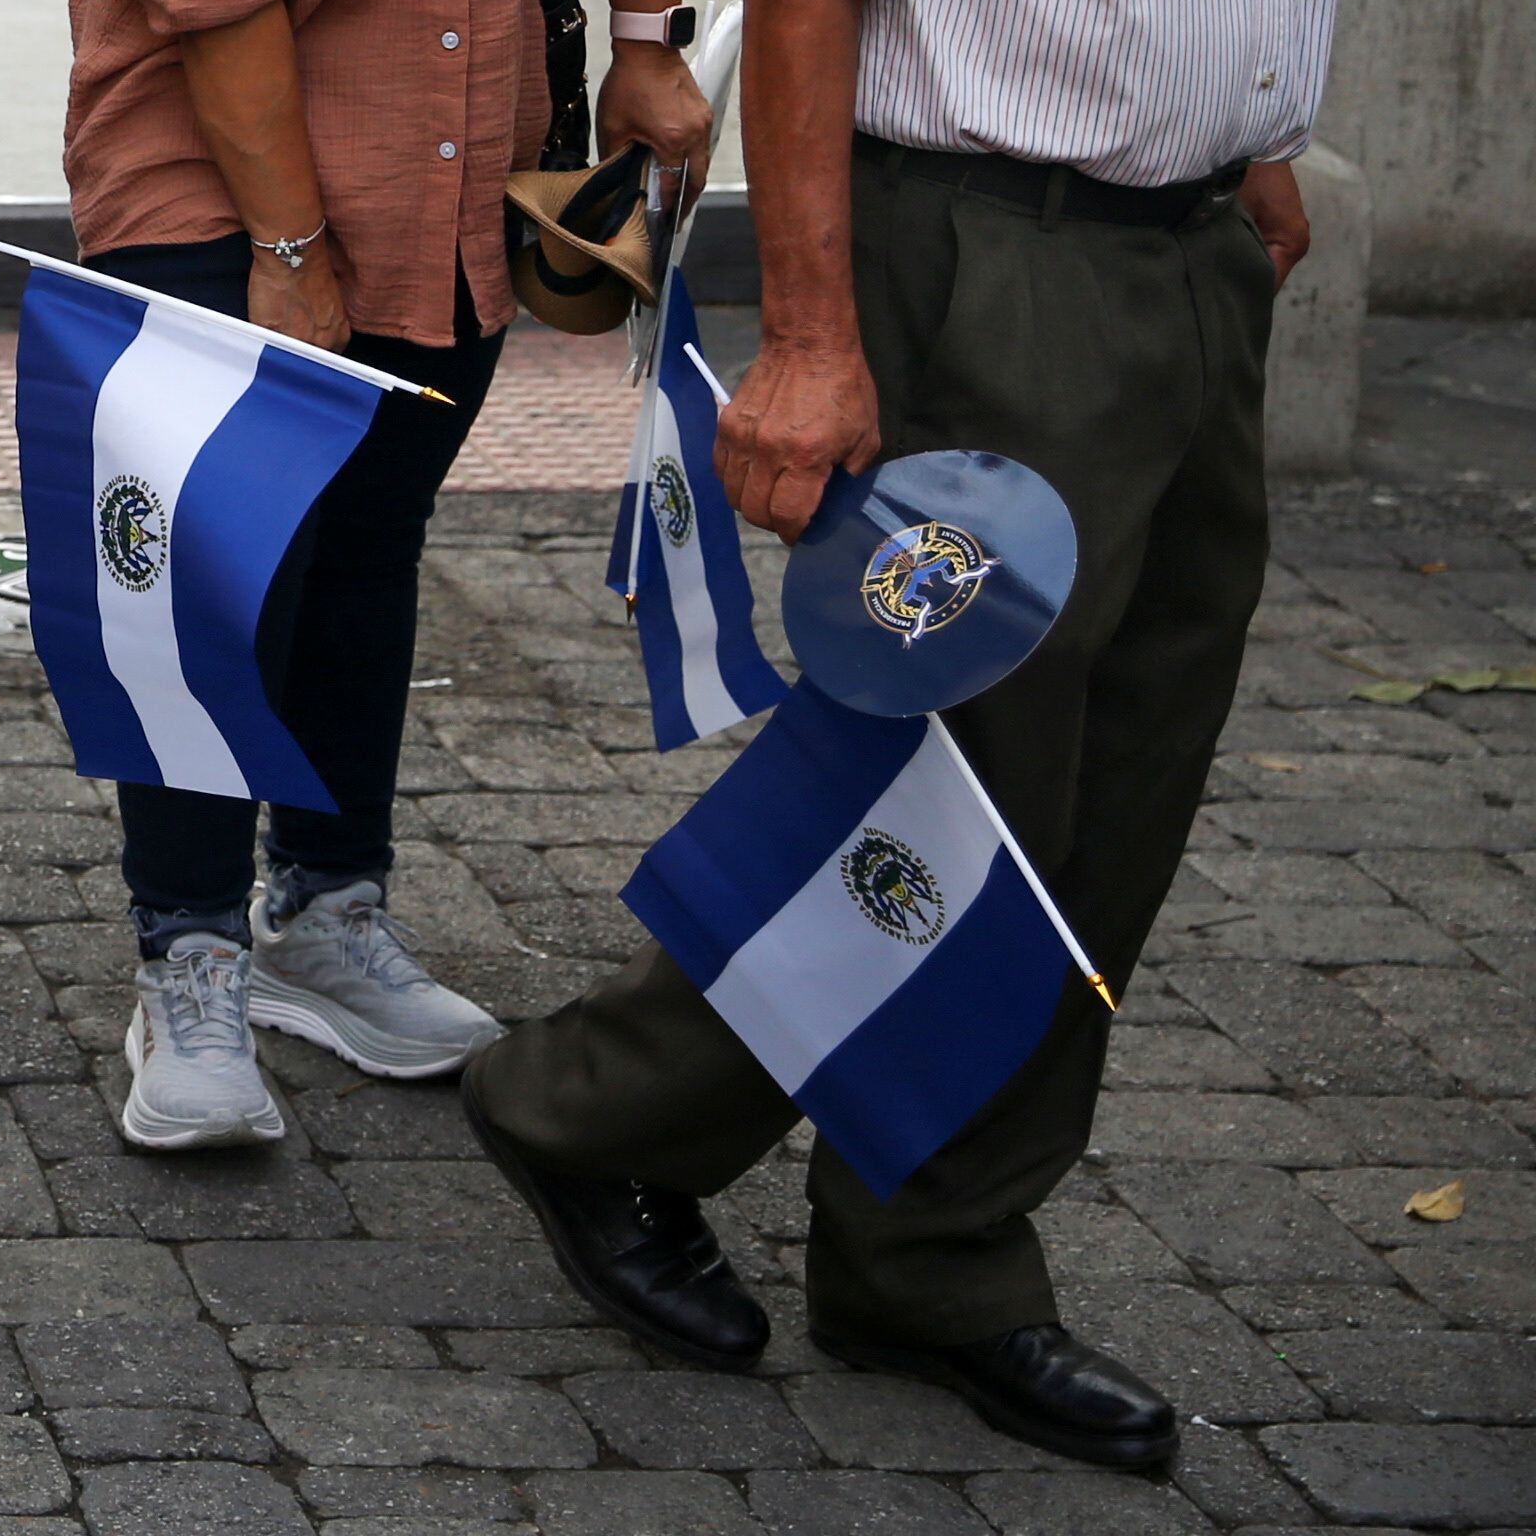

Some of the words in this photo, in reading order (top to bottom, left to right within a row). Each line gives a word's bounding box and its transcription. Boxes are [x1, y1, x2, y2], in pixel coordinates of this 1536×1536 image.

[96, 474, 127, 509] REPUBLICA
[150, 491, 168, 549] SALVADOR
[941, 529, 977, 567] INVESTIDURA
